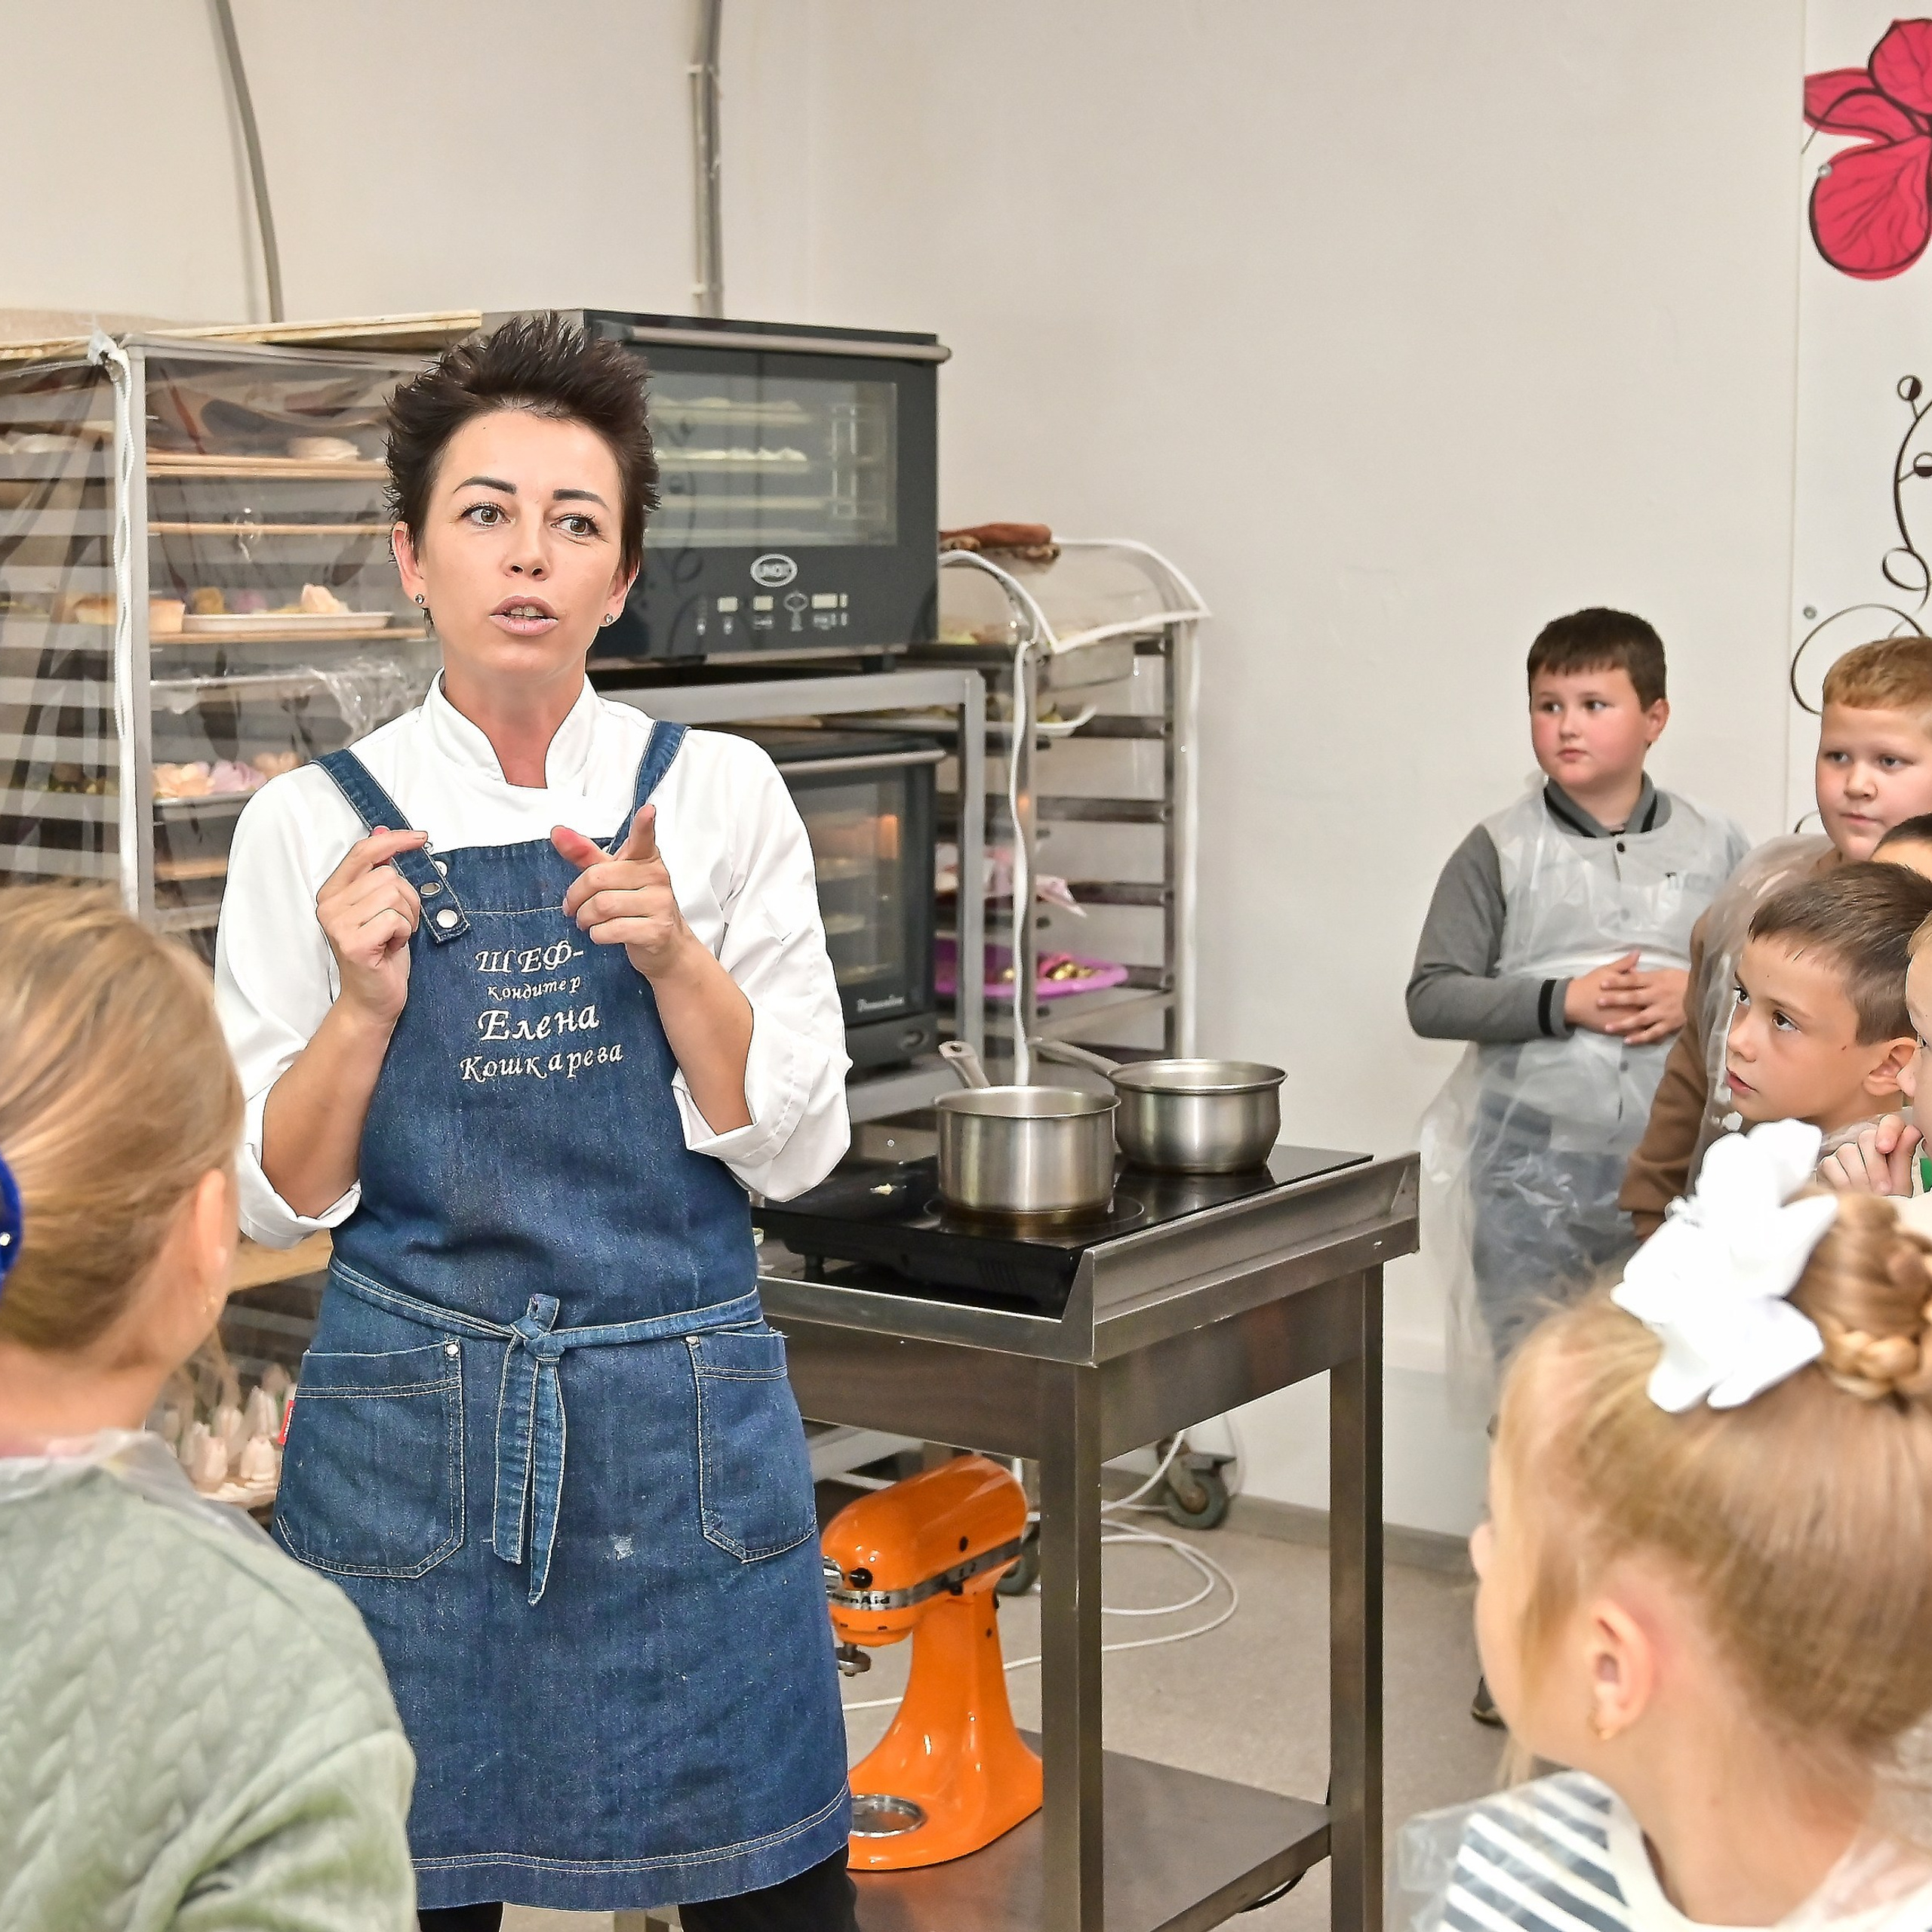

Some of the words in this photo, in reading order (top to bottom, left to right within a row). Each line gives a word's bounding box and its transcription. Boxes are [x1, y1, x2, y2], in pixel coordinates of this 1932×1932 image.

[475, 940, 584, 973] ШЕФ-
[477, 1004, 601, 1041] Елена
[460, 1044, 624, 1083] Кошкарева
